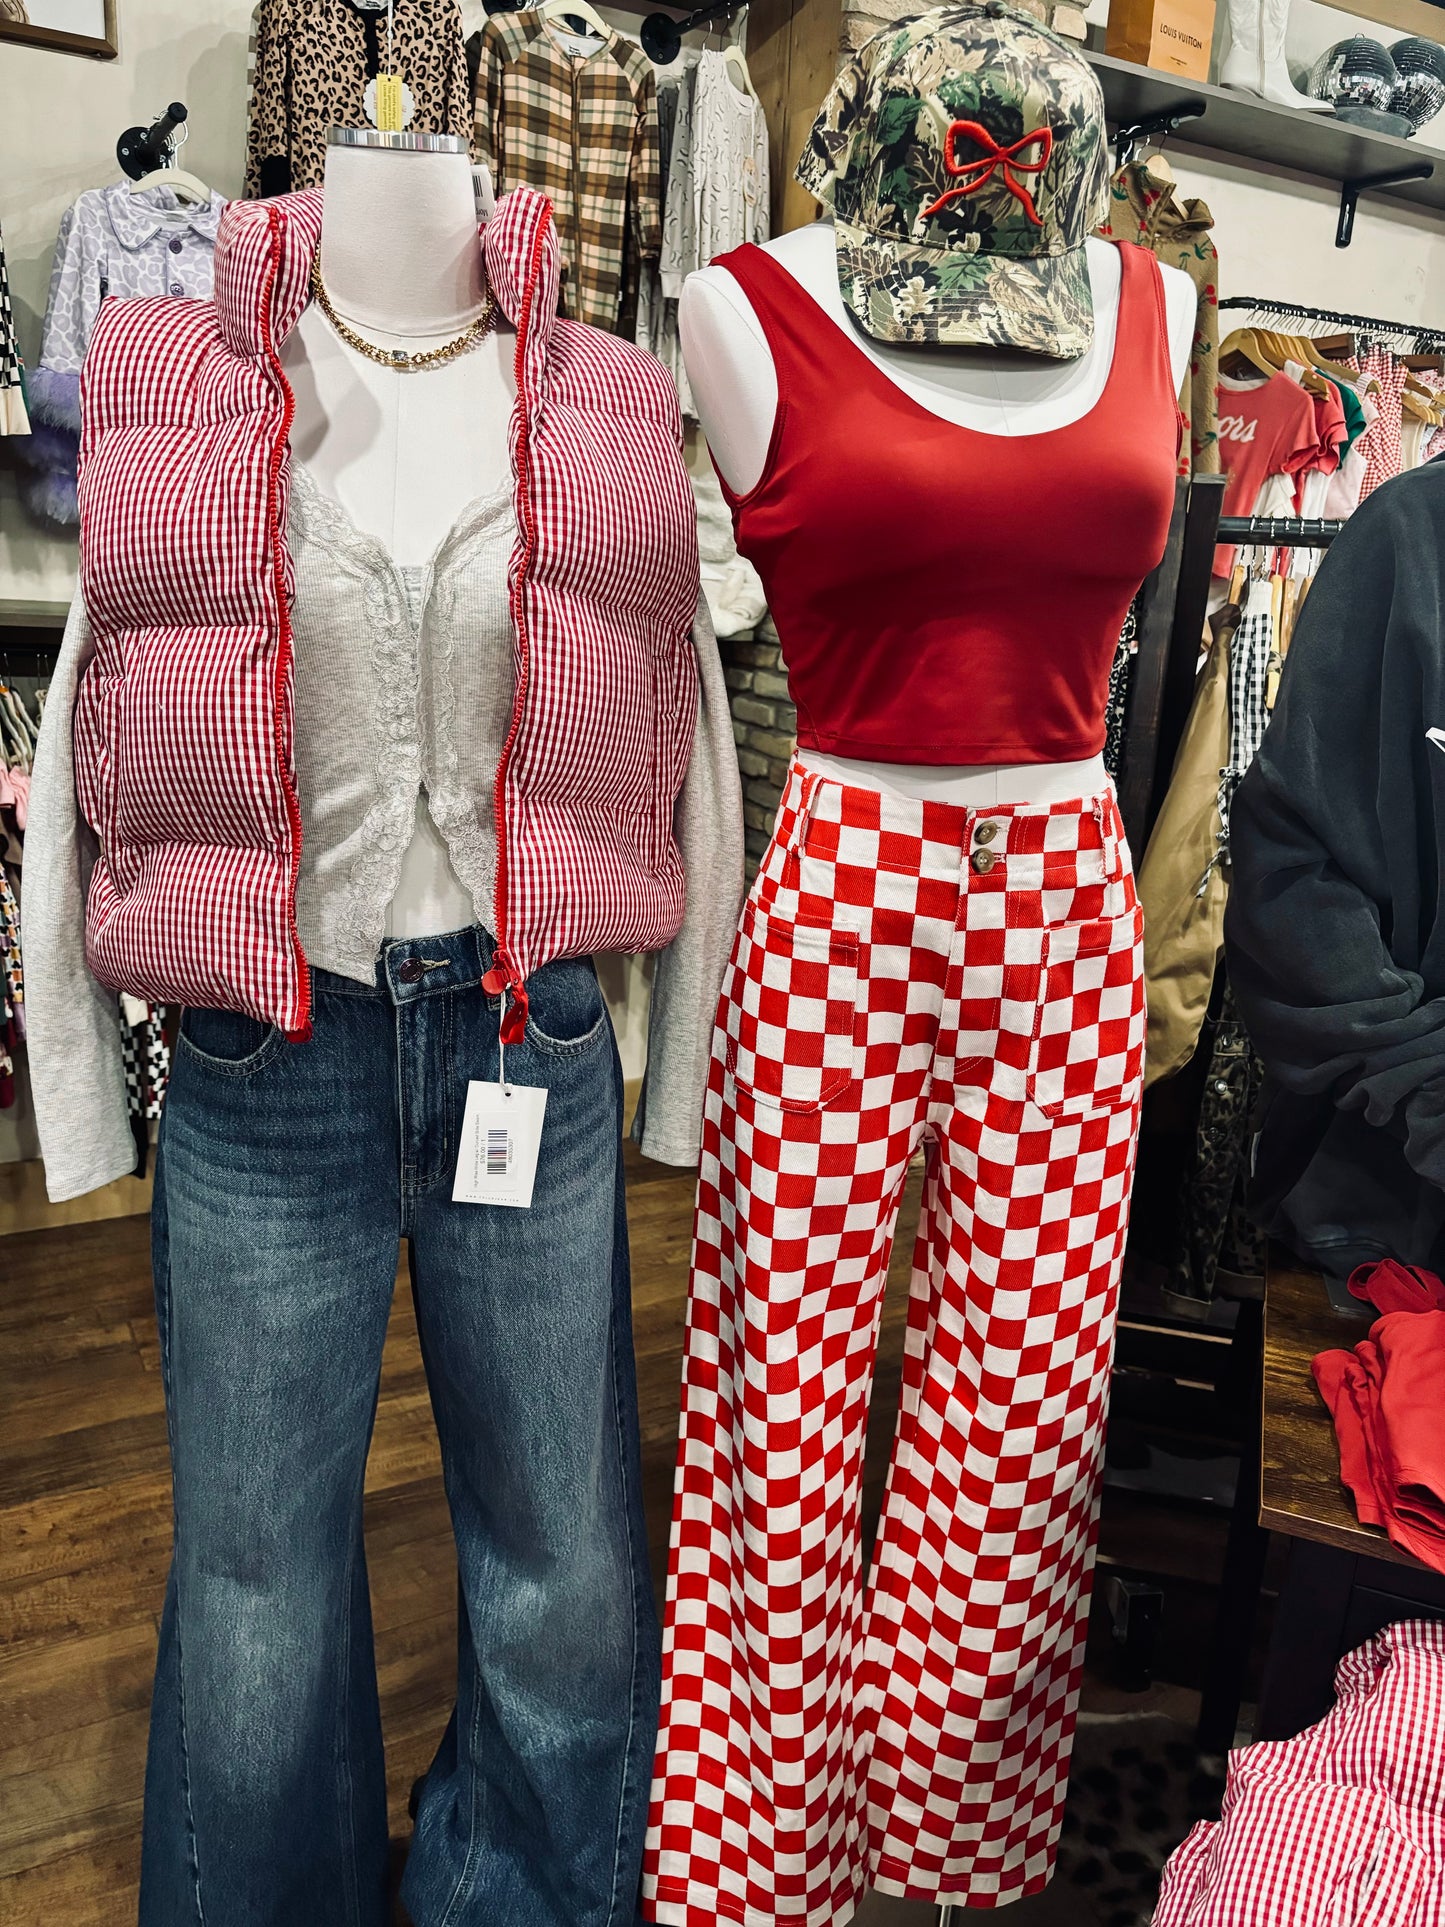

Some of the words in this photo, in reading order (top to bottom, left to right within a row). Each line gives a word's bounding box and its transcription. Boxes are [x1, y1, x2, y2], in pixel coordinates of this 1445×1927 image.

[1160, 23, 1177, 39] LOUIS
[1178, 31, 1202, 49] VUITTON
[1218, 415, 1258, 443] ors
